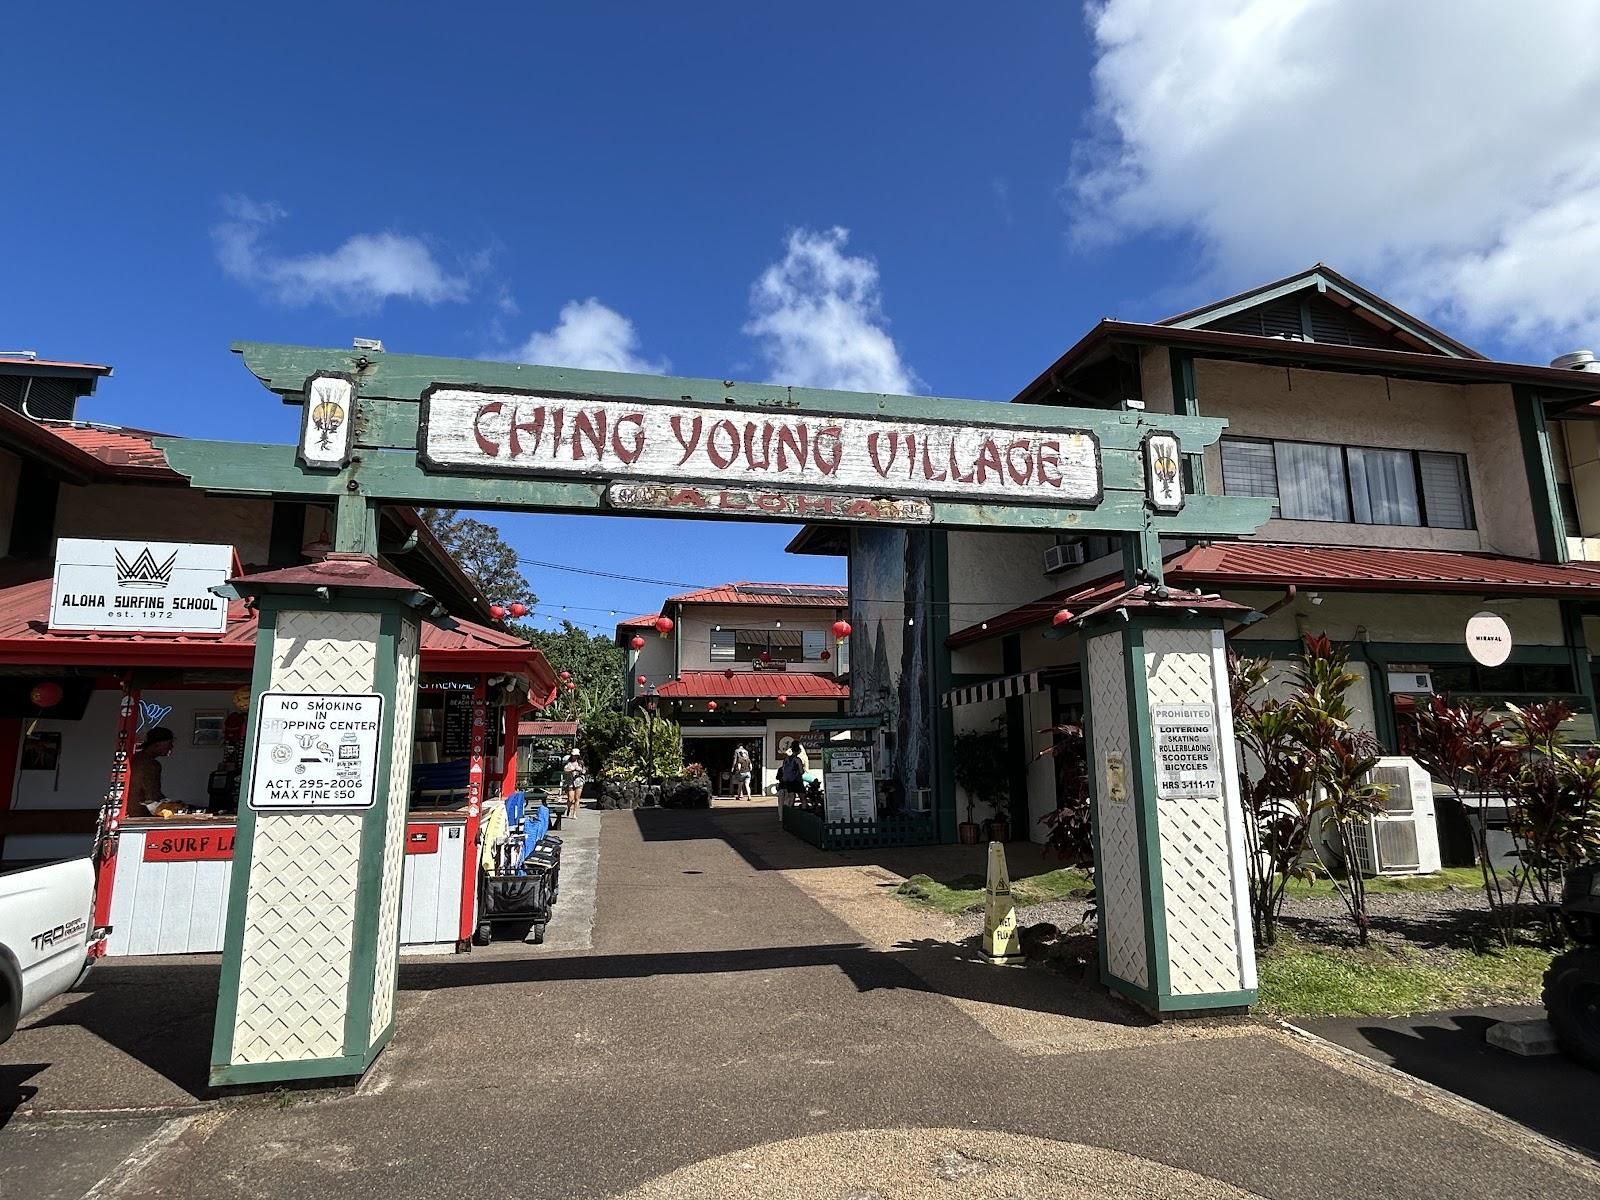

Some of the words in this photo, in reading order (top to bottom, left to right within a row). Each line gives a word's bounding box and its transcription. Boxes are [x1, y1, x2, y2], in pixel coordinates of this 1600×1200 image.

[473, 401, 645, 464] CHING
[670, 415, 843, 476] YOUNG
[867, 431, 1064, 488] VILLAGE
[668, 489, 880, 518] ALOHA
[62, 594, 105, 607] ALOHA
[114, 595, 165, 609] SURFING
[172, 597, 218, 610] SCHOOL
[142, 611, 173, 619] 1972
[281, 701, 299, 710] NO
[307, 701, 362, 711] SMOKING
[315, 711, 327, 720] IN
[330, 721, 377, 730] CENTER
[1168, 735, 1200, 743] SKATING
[1159, 744, 1211, 752] ROLLERBLADING
[1165, 763, 1208, 771] BICYCLES
[265, 779, 294, 789] ACT.
[299, 779, 363, 789] 295-2006
[1162, 781, 1180, 789] HRS
[1181, 780, 1215, 789] 3-111-17
[270, 790, 299, 799] MAX
[303, 790, 331, 799] FINE
[334, 790, 356, 799] $50
[161, 837, 210, 853] SURF
[31, 924, 64, 951] TRD
